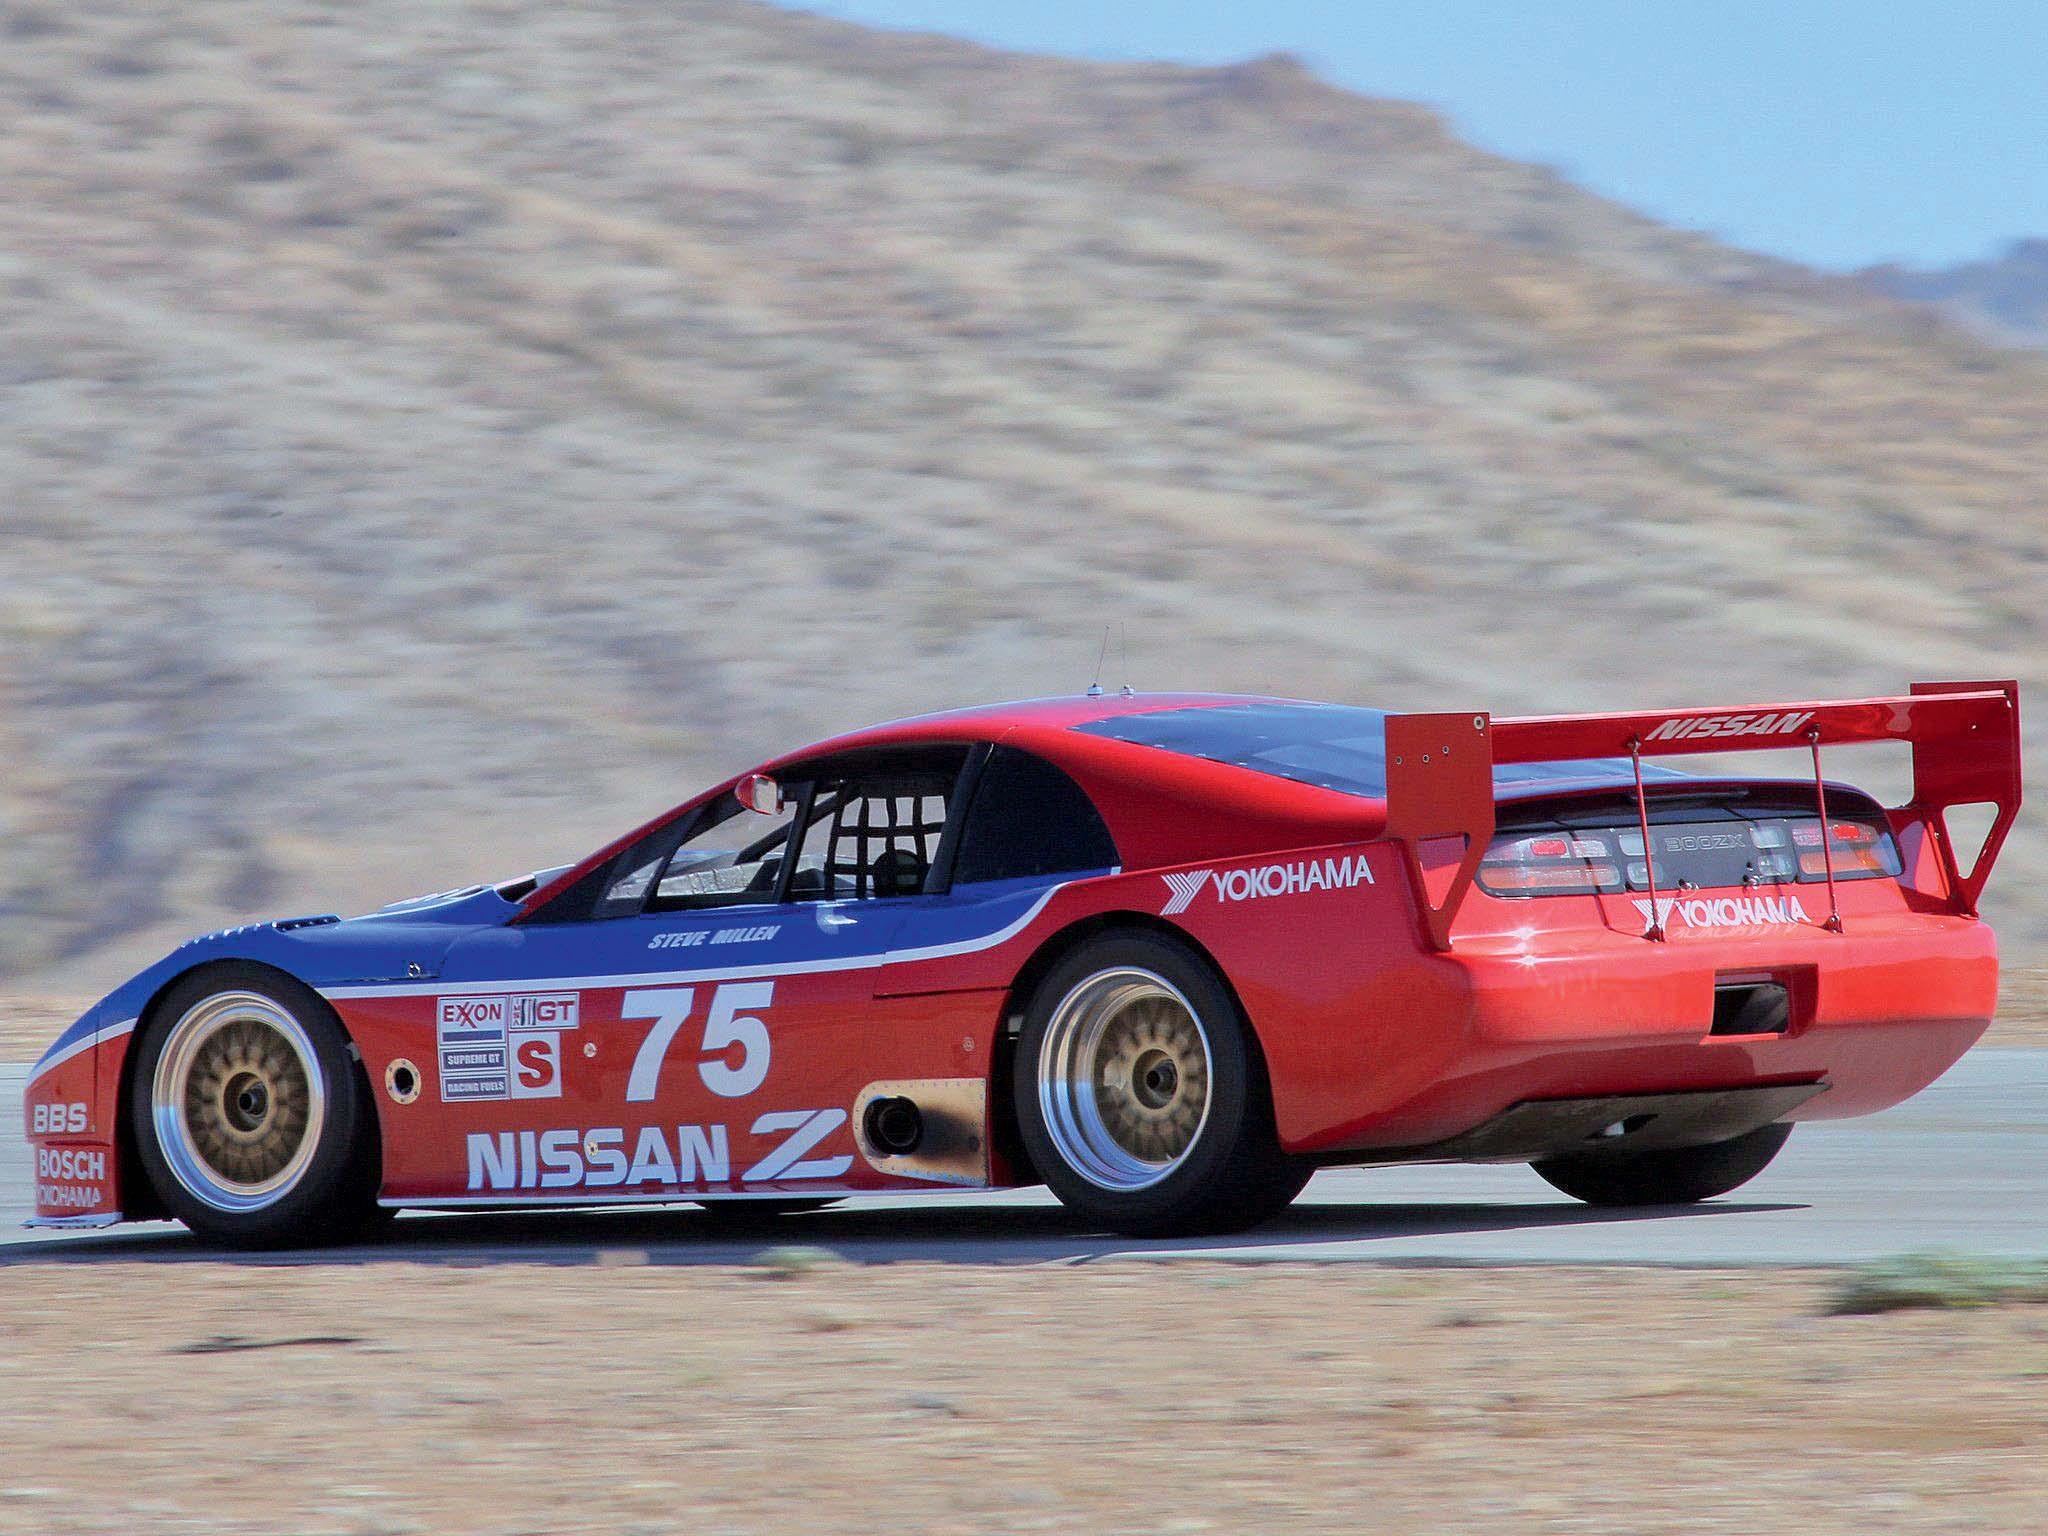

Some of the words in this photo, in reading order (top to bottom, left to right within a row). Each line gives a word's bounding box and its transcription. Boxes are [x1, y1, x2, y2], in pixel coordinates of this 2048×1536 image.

[1645, 711, 1815, 741] NISSAN
[1665, 834, 1746, 852] 300ZX
[1212, 855, 1375, 903] YOKOHAMA
[1674, 896, 1812, 928] YOKOHAMA
[648, 930, 712, 949] STEVE
[709, 925, 781, 944] MILLEN
[443, 1001, 502, 1029] EXXON
[537, 1000, 576, 1022] GT
[621, 981, 775, 1102] 75
[447, 1053, 488, 1065] SUPREME
[488, 1053, 500, 1064] GT
[517, 1041, 554, 1089] S
[447, 1082, 479, 1093] RACING
[480, 1081, 504, 1092] FUELS
[34, 1103, 88, 1134] BBS
[39, 1148, 105, 1180] BOSCH
[466, 1124, 731, 1190] NISSAN
